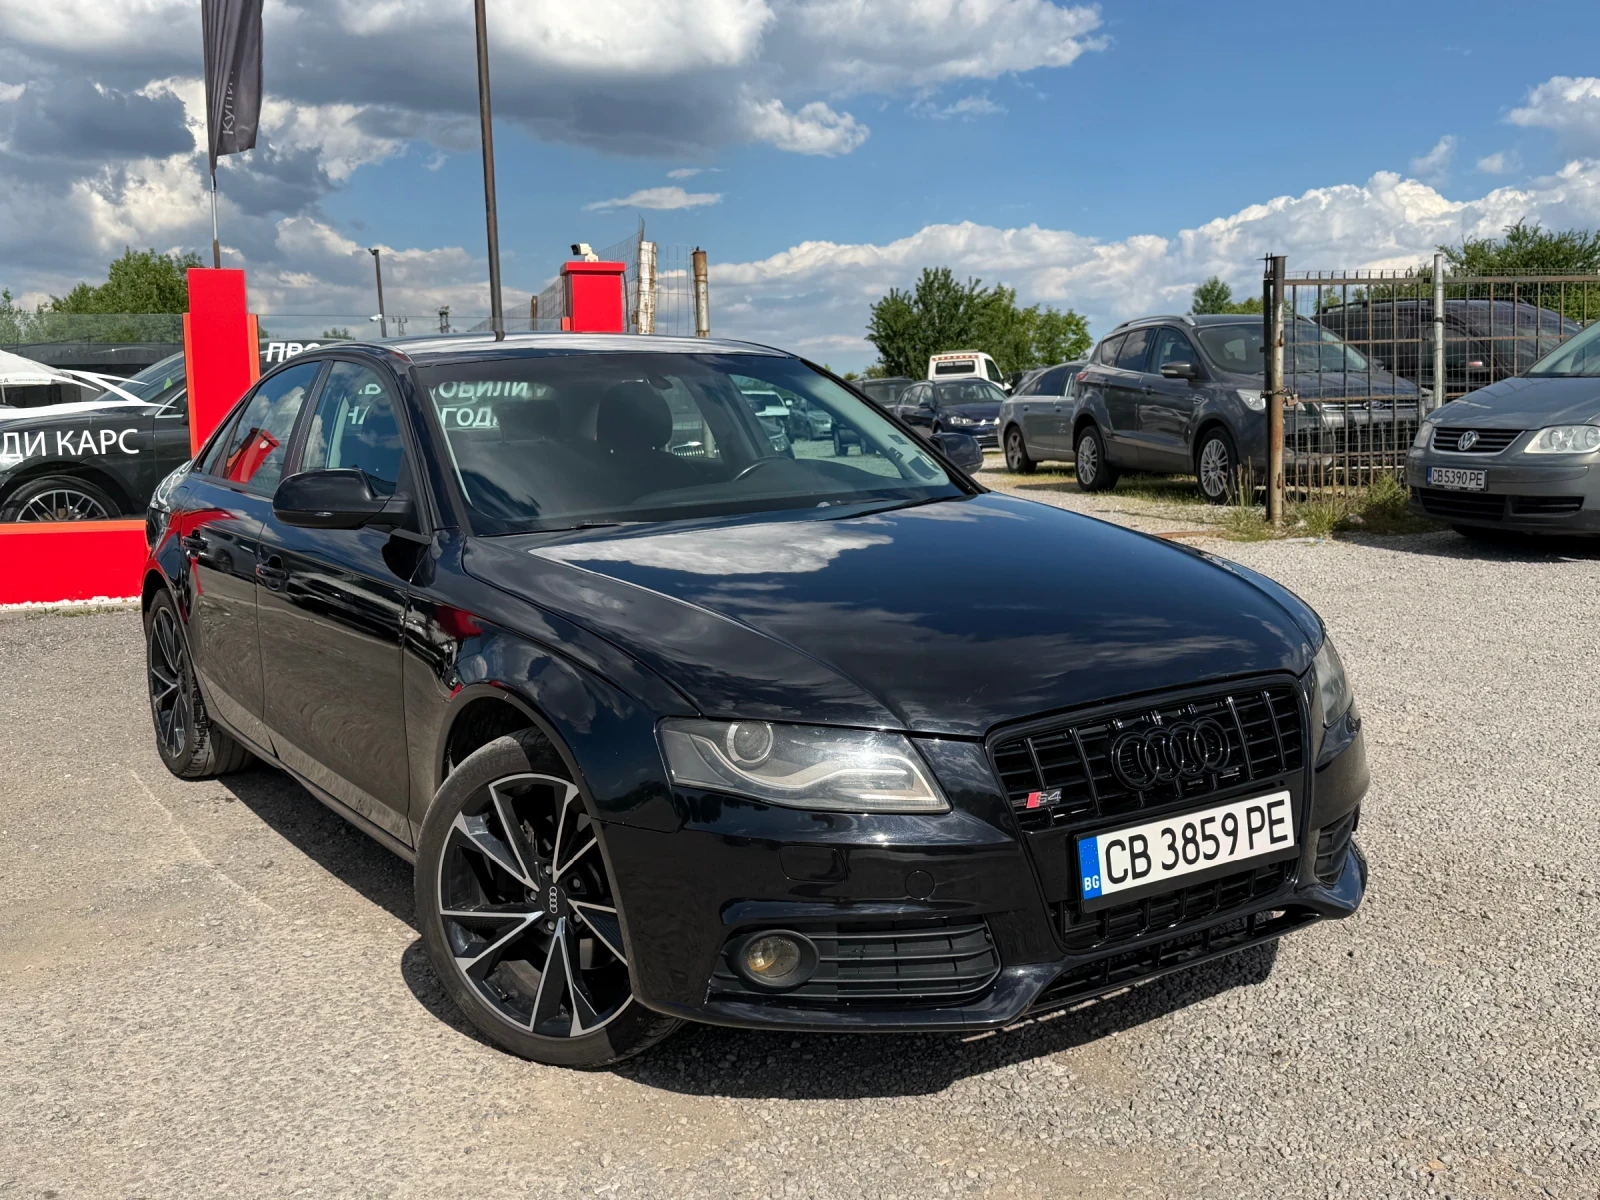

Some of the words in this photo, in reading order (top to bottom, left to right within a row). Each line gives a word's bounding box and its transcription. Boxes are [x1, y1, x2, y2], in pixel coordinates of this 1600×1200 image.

[56, 428, 140, 456] КАРС
[1444, 470, 1468, 485] 5390
[1160, 812, 1240, 872] 3859
[1246, 799, 1289, 851] PE
[1084, 875, 1100, 891] BG
